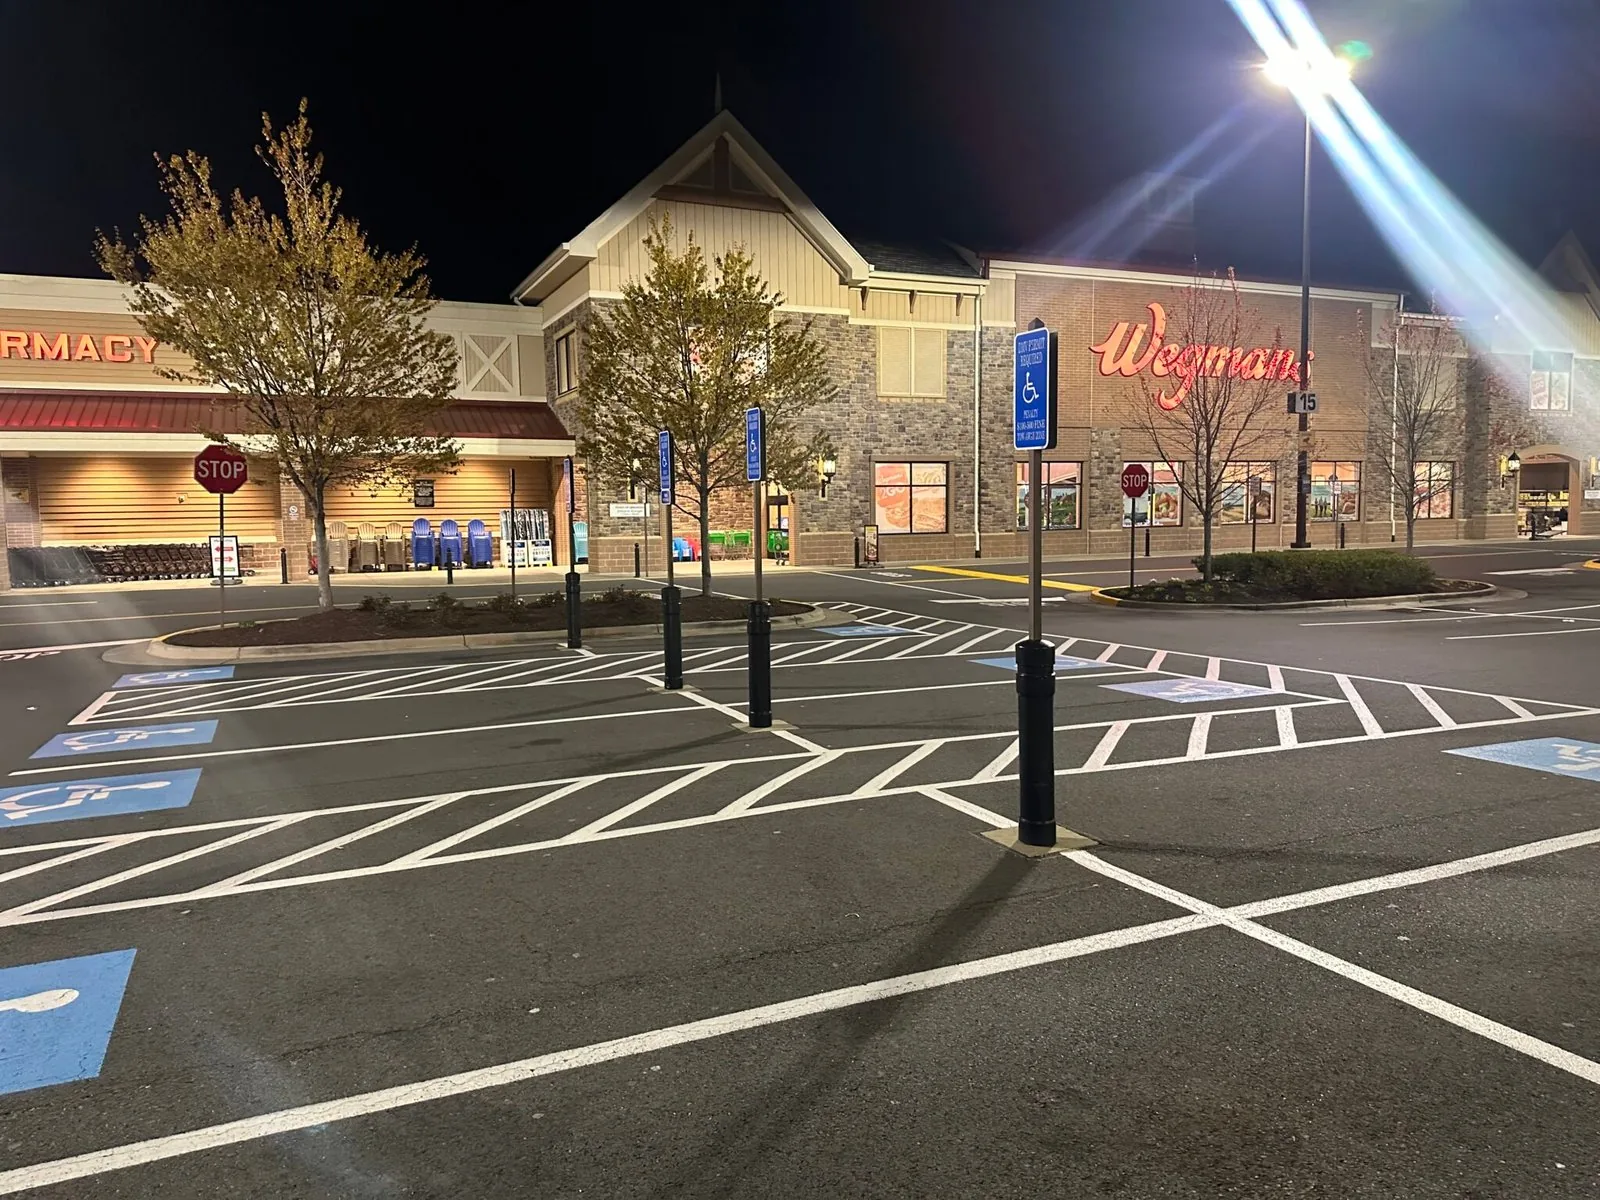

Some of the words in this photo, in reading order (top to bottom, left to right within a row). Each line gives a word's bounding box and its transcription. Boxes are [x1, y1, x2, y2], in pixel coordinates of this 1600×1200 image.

[1089, 302, 1314, 410] Wegmans
[1300, 393, 1316, 411] 15
[197, 460, 245, 479] STOP
[1122, 474, 1148, 488] STOP
